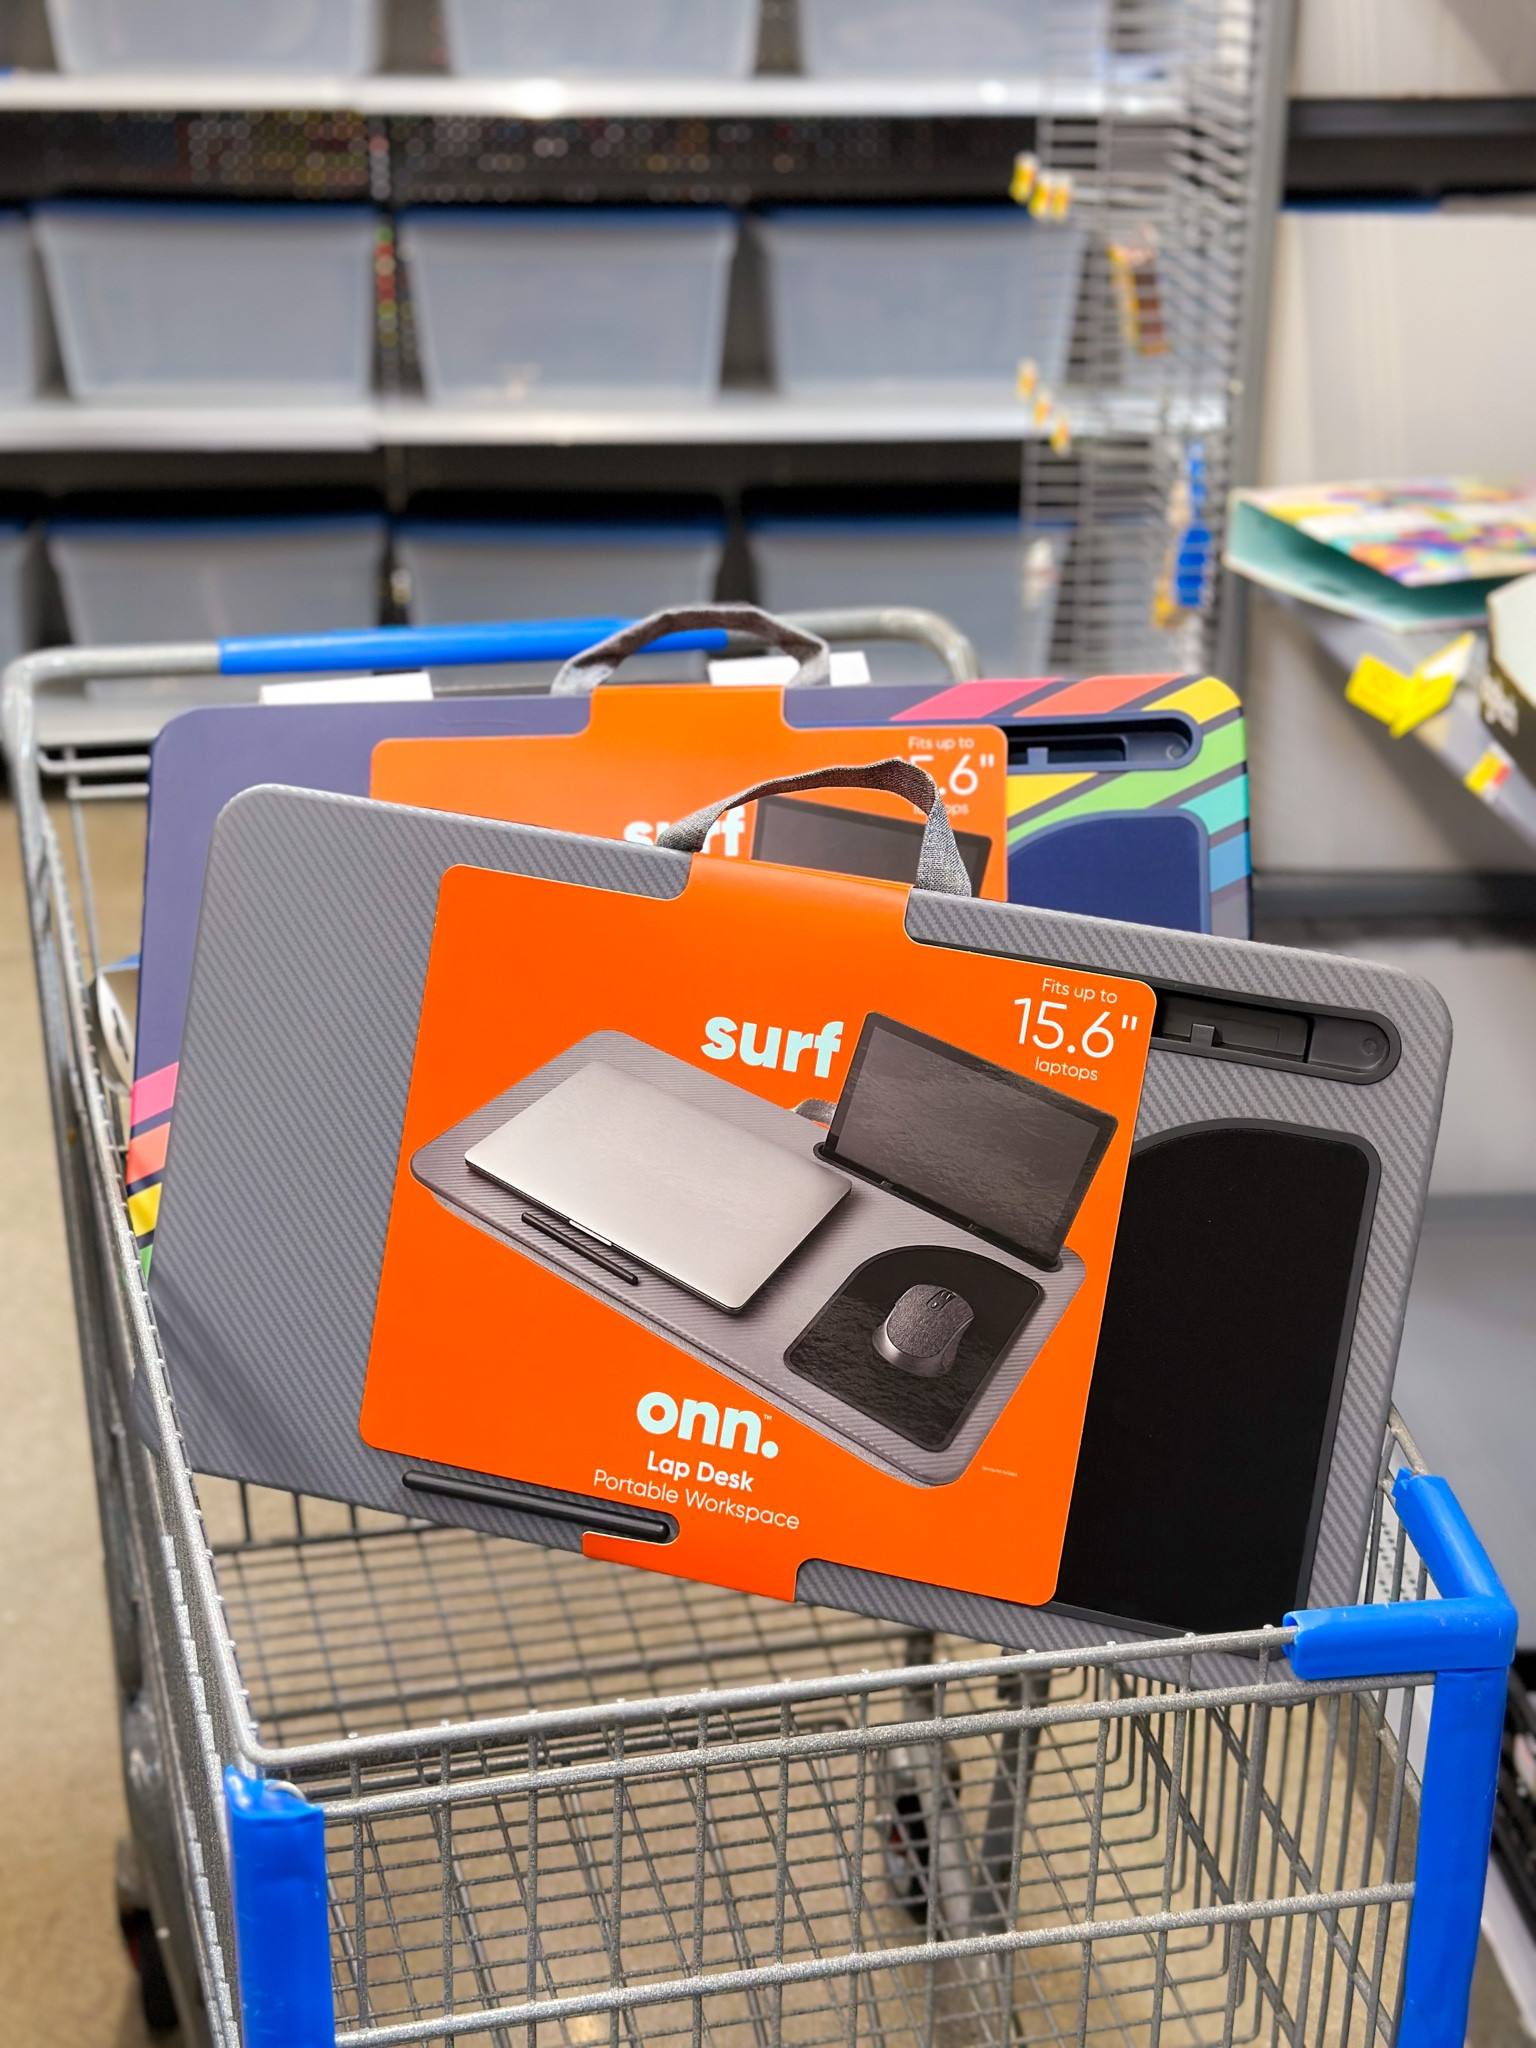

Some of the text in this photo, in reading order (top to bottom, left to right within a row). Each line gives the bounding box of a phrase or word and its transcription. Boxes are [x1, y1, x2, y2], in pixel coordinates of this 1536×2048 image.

[908, 736, 975, 752] Fits up to
[623, 804, 746, 857] srf
[1042, 977, 1118, 1004] Fits up to
[701, 1016, 844, 1079] surf
[1014, 997, 1139, 1058] 15.6"
[1035, 1056, 1099, 1081] laptops
[647, 1450, 755, 1492] Lap Desk
[594, 1469, 800, 1530] Portable Workspace
